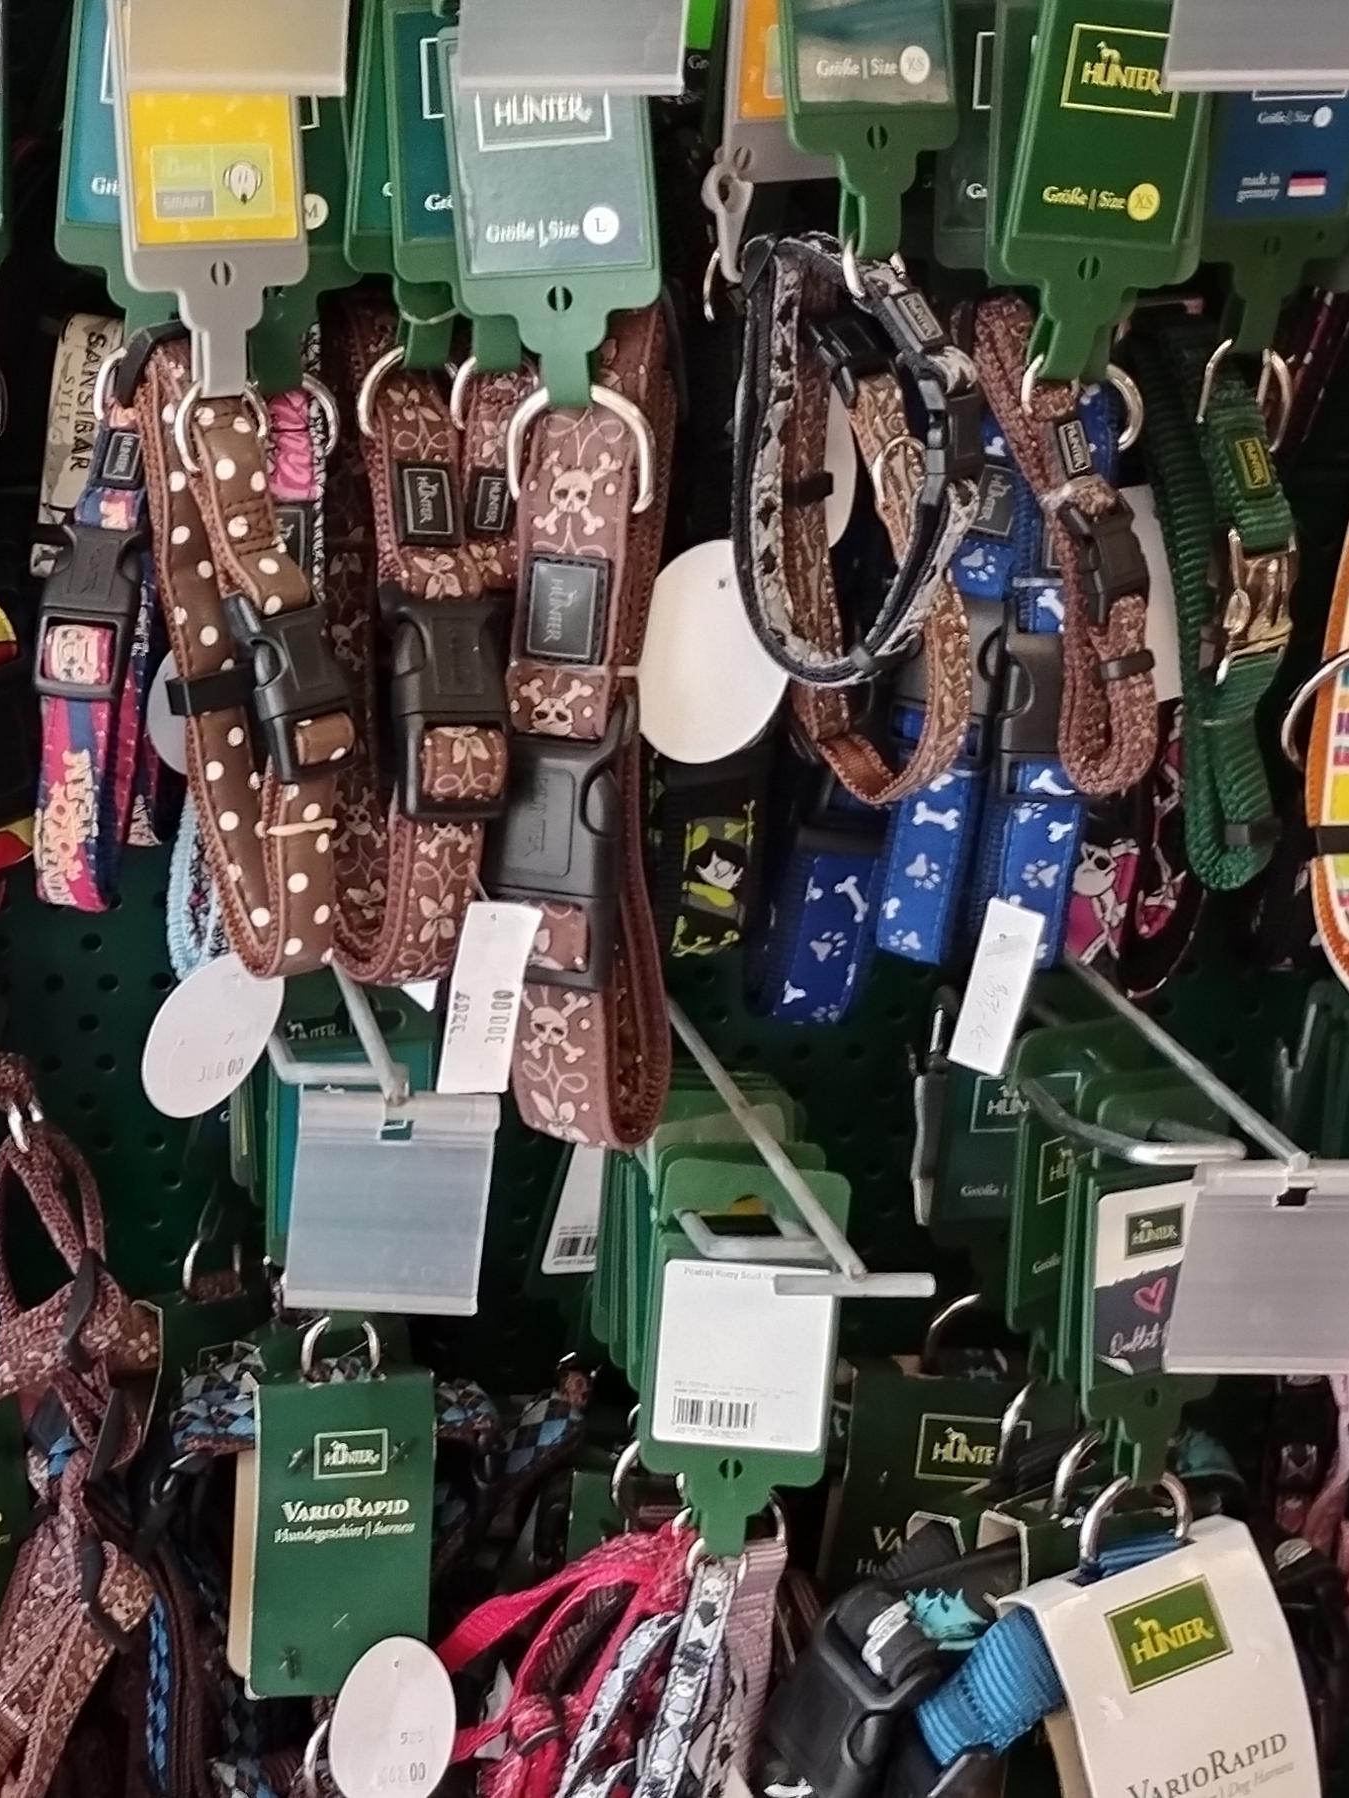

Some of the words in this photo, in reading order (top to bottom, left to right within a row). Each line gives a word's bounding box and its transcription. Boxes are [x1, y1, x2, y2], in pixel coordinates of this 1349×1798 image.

[1081, 60, 1164, 96] HUNTER
[494, 92, 591, 127] HUNTER
[58, 375, 75, 424] SYLT
[70, 330, 106, 473] SANSIBAR
[416, 475, 438, 525] HUNTER
[544, 578, 570, 645] HUNTER
[484, 989, 516, 1045] 300.00
[323, 1447, 381, 1466] HUNTER
[931, 1440, 997, 1467] HUNTE
[1129, 1617, 1215, 1666] HUNTER
